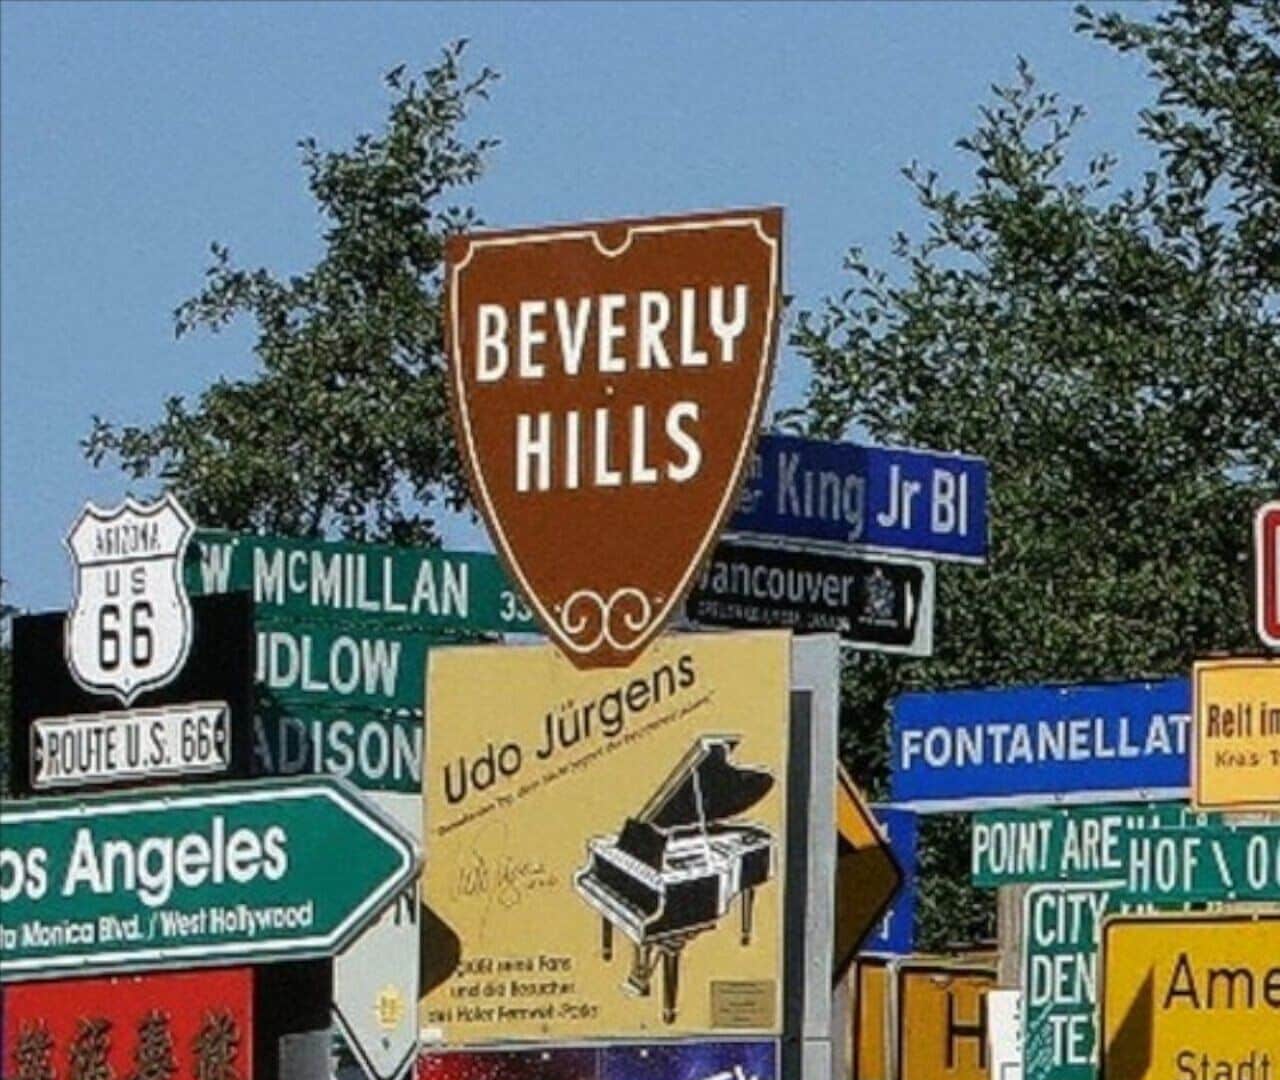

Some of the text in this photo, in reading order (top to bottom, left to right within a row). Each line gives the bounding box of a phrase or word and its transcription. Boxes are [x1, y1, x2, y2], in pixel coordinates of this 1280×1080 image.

[475, 285, 748, 382] BEVERLY
[515, 402, 701, 493] HILLS
[777, 452, 969, 541] King Jr Bl
[104, 568, 146, 596] US
[201, 543, 232, 595] W
[100, 602, 154, 669] 66
[48, 714, 210, 775] ROUTE U.S. 66
[443, 744, 523, 805] Udo
[535, 655, 697, 760] Jürgens
[62, 817, 287, 905] Angeles
[973, 822, 1053, 876] POINT
[1130, 837, 1200, 892] HOF
[22, 920, 94, 949] Monica
[100, 914, 144, 940] Blvd.
[160, 910, 207, 938] West
[212, 902, 313, 936] Hollywood
[1035, 891, 1109, 946] CITY
